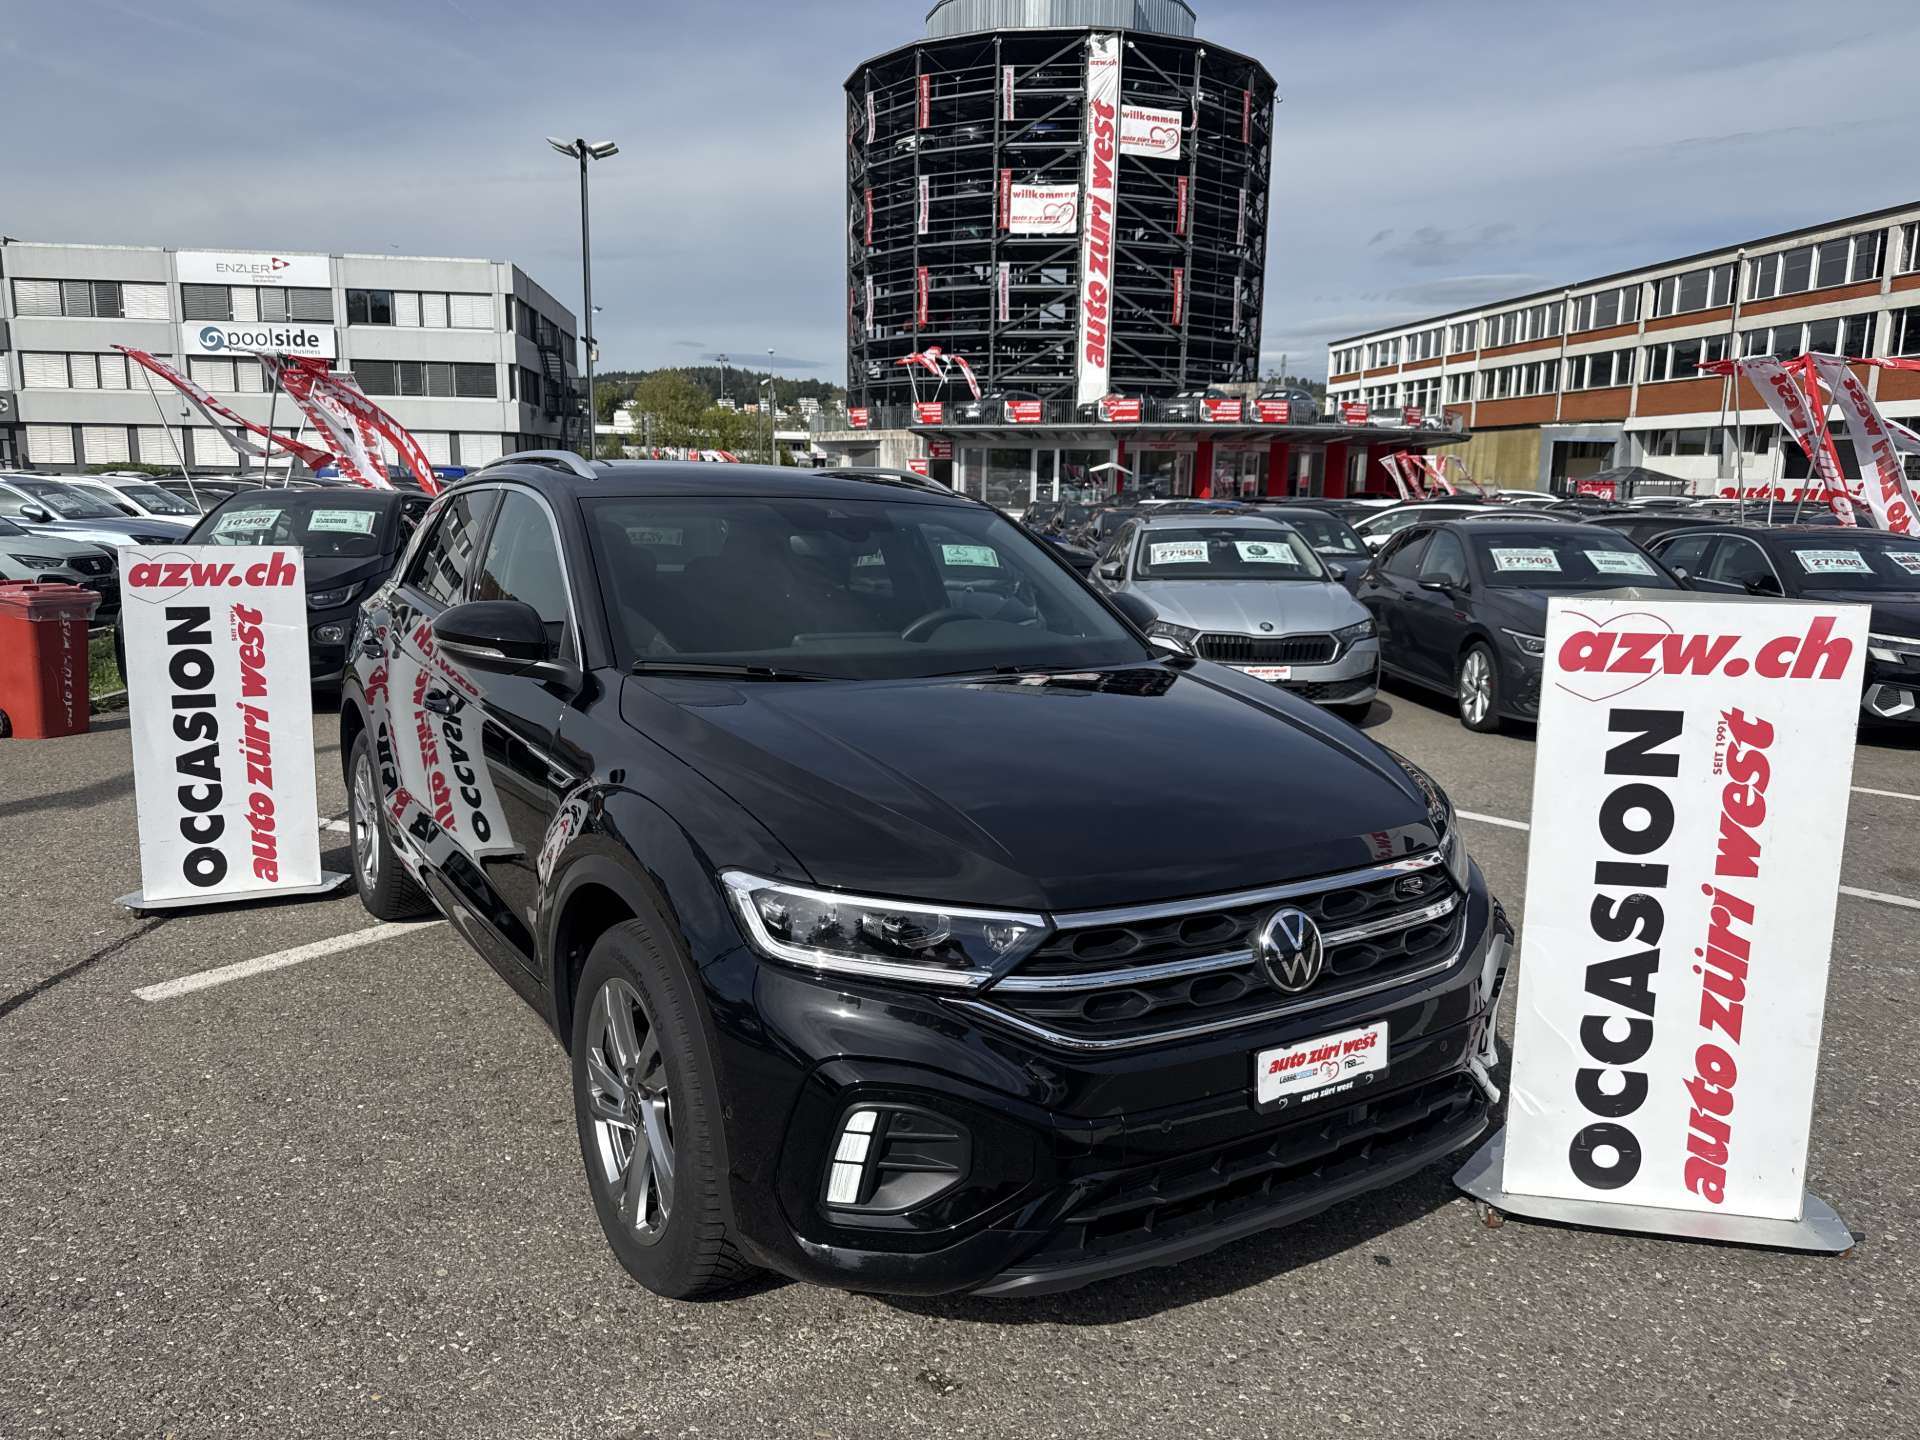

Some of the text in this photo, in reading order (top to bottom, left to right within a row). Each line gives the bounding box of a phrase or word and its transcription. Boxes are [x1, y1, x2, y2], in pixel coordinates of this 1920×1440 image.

[1121, 111, 1180, 125] willkommen
[1012, 190, 1076, 199] willkommen
[1084, 97, 1115, 368] auto züri west
[216, 263, 271, 274] ENZLER
[228, 327, 319, 352] poolside
[128, 552, 297, 588] azw.ch
[1160, 549, 1204, 558] 27'550
[1504, 556, 1553, 565] 27'500
[1811, 558, 1862, 566] 27'400
[1557, 616, 1854, 680] azw.ch
[165, 606, 228, 887] OCCASION
[229, 602, 279, 883] auto züri west
[1713, 720, 1727, 775] SEIT 1991
[1569, 708, 1685, 1190] OCCASION
[1682, 707, 1776, 1205] auto züri west
[1269, 1032, 1378, 1074] auto züri west
[1301, 1080, 1354, 1103] auto züri west
